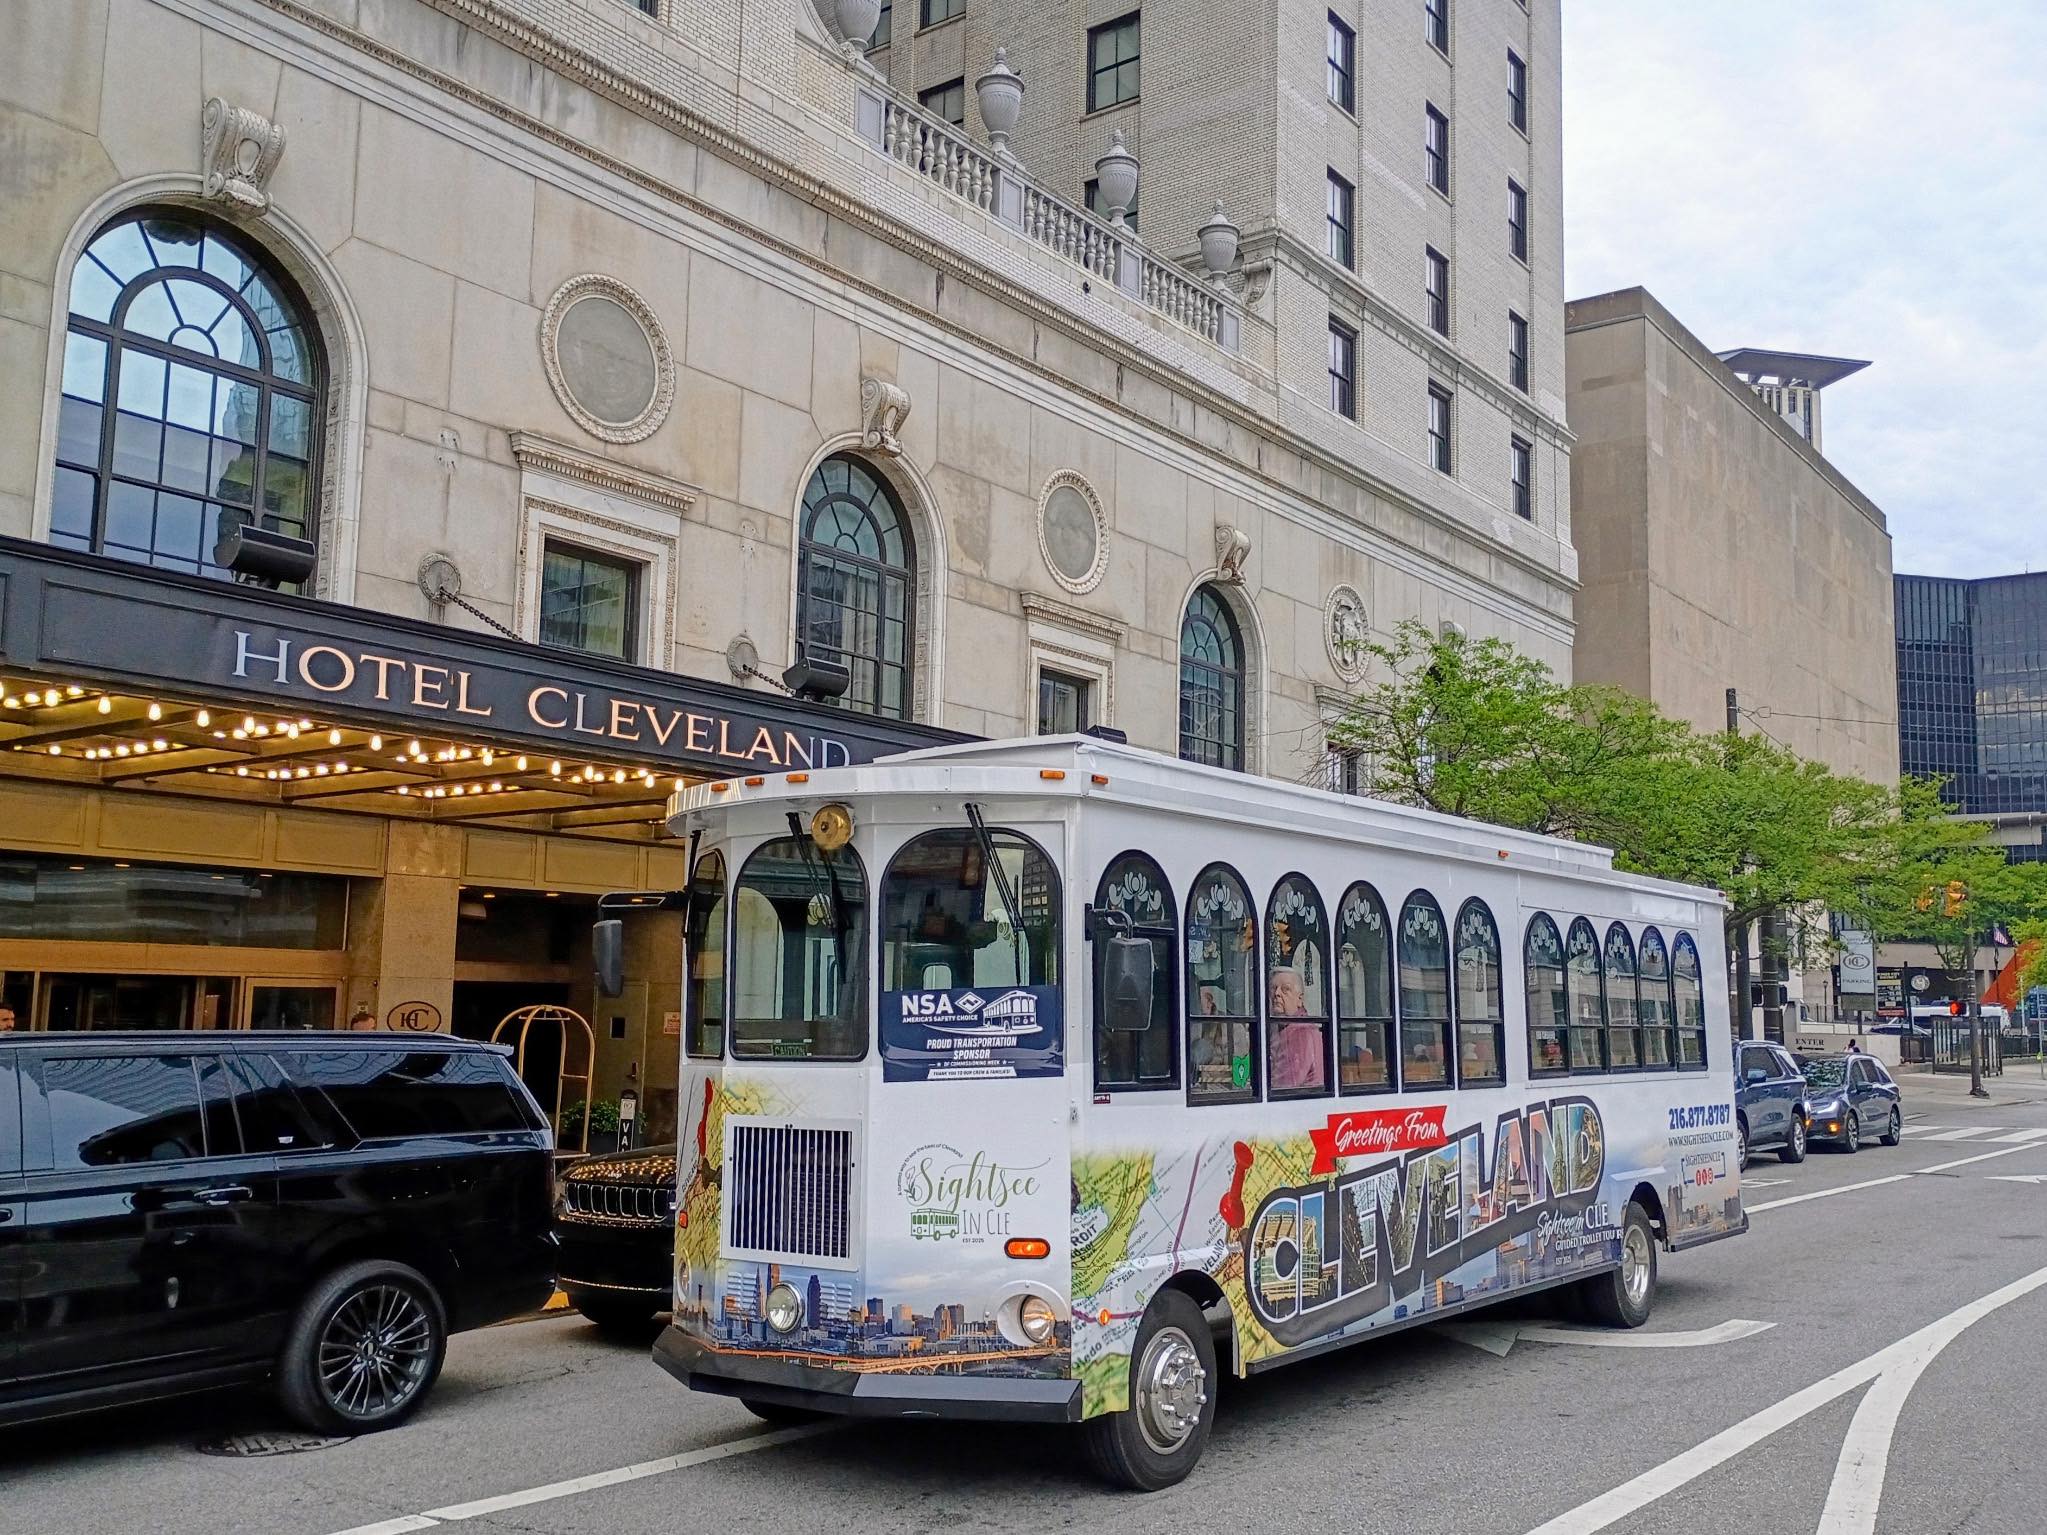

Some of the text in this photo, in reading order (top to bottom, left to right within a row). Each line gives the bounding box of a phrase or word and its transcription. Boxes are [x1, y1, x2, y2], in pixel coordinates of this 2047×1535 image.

[232, 630, 851, 769] HOTEL CLEVELAND
[901, 993, 954, 1016] NSA
[902, 1014, 978, 1024] AMERICA'S SAFETY CHOICE
[926, 1036, 1018, 1050] PROUD TRANSPORTATION
[953, 1049, 991, 1060] SPONSOR
[1795, 1038, 1825, 1046] ENTER
[1668, 1103, 1730, 1130] 216.877.8787
[621, 1121, 631, 1152] VA
[1334, 1111, 1439, 1153] Greetings From
[906, 1151, 1051, 1214] Sightsee
[1249, 1101, 1604, 1324] CLEVELAND
[1585, 1203, 1609, 1229] CLE
[1555, 1237, 1578, 1251] GUIDED
[1579, 1233, 1602, 1245] TROLLEY
